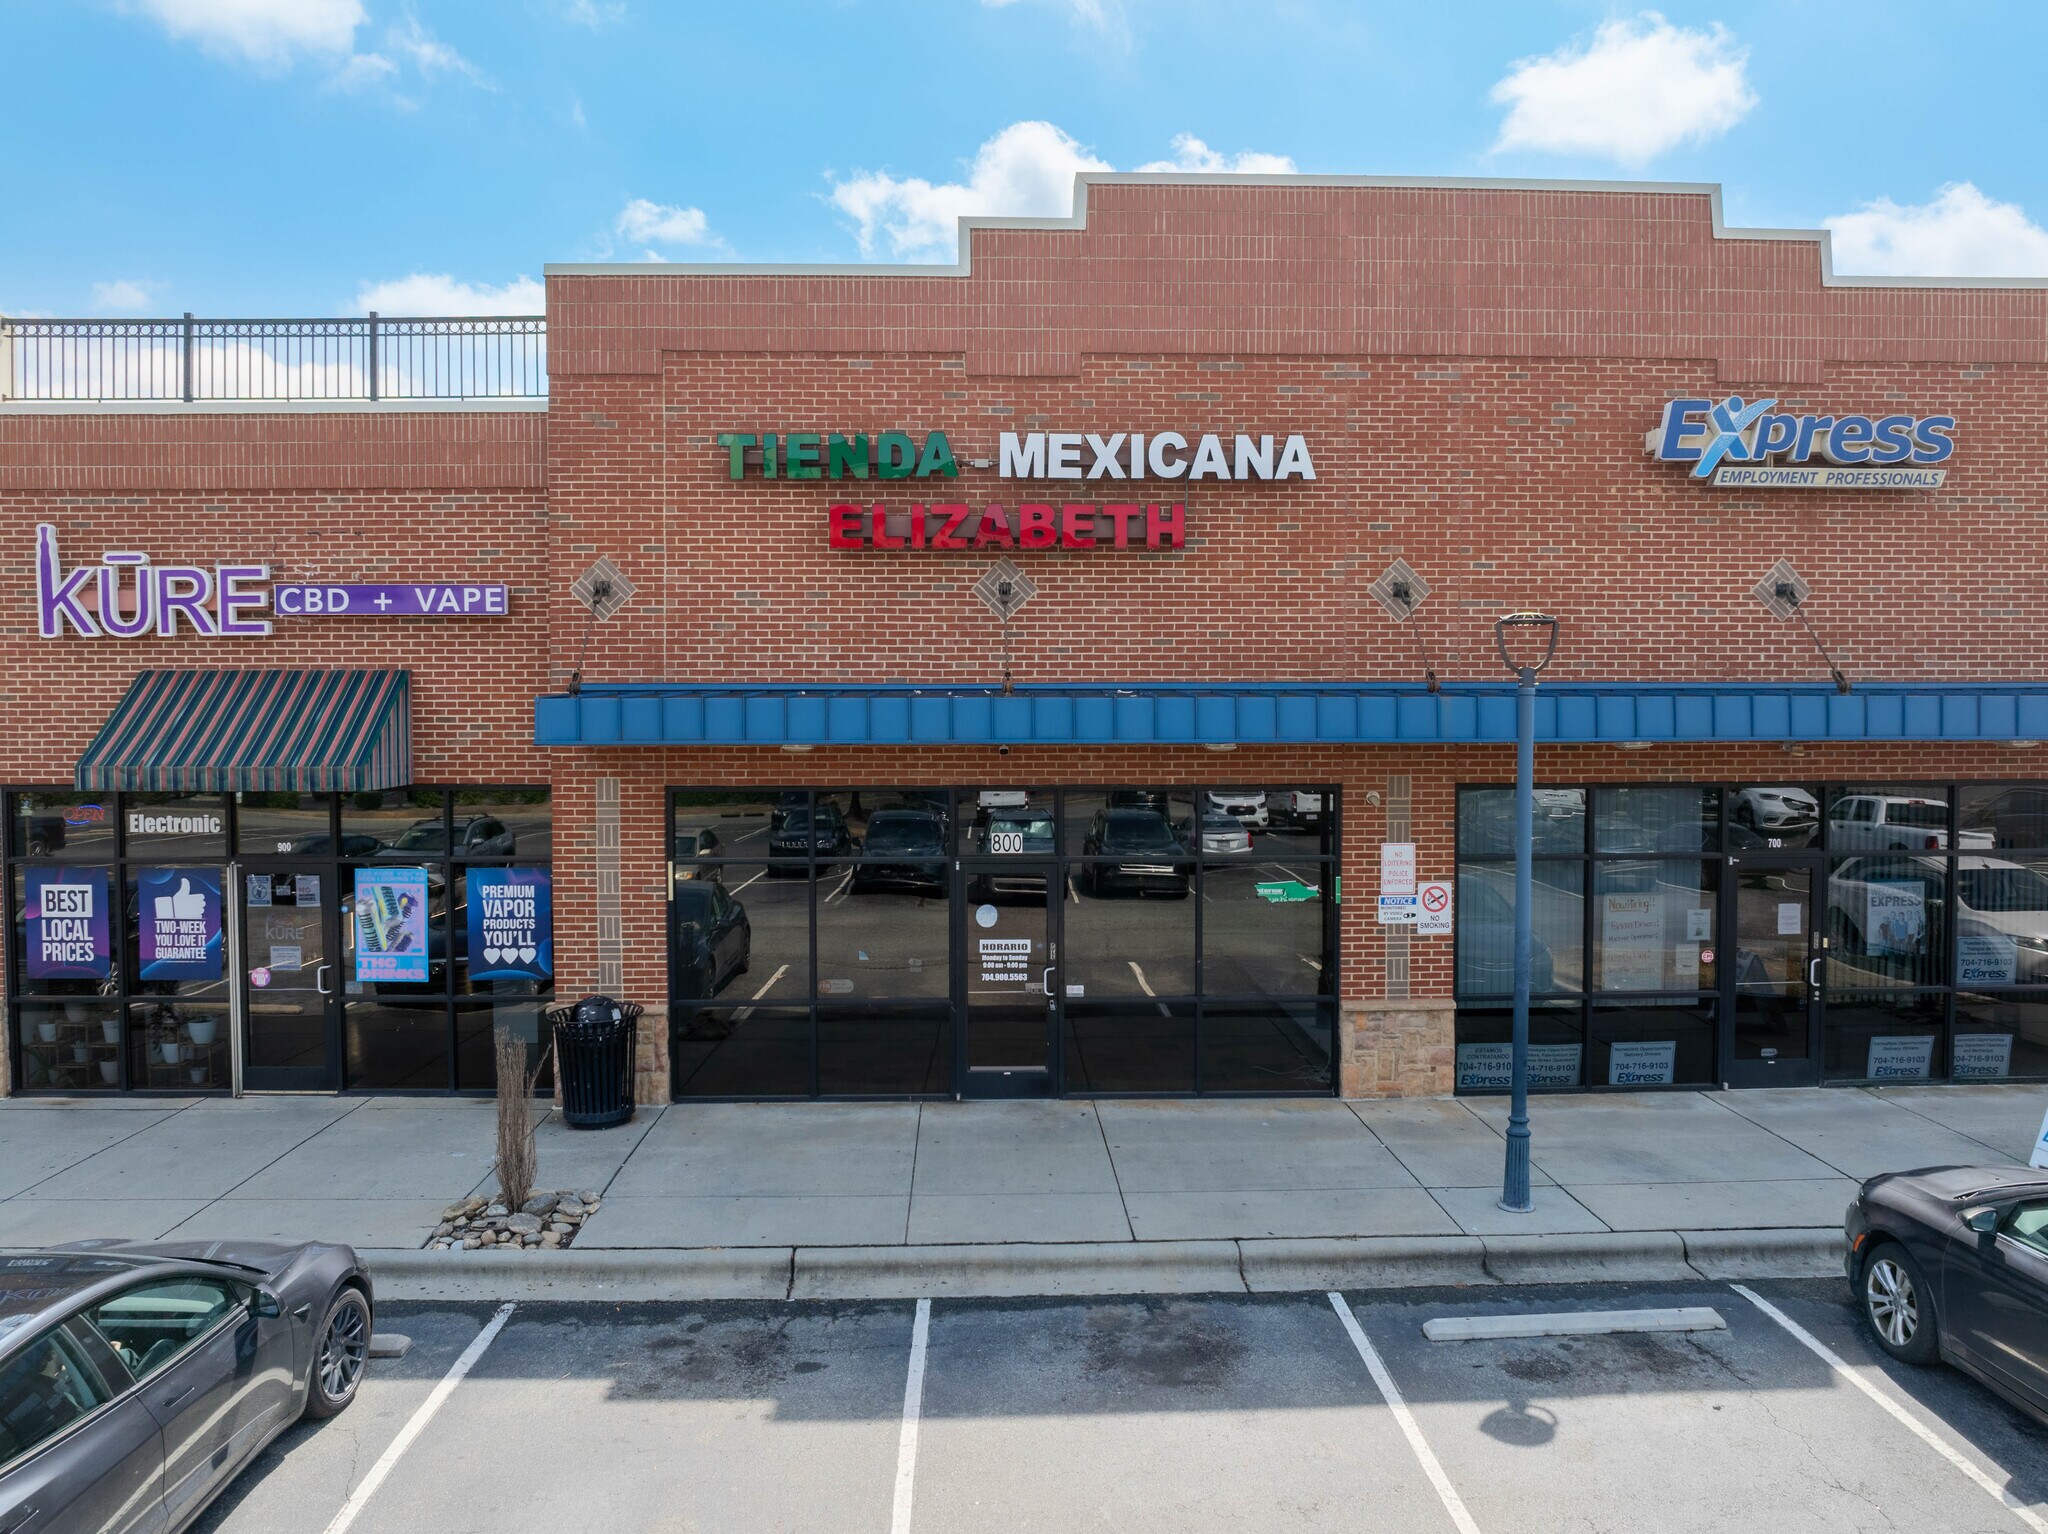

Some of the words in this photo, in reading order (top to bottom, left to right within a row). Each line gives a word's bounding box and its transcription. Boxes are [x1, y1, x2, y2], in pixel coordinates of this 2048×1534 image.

[716, 432, 959, 480] TIENDA
[999, 431, 1317, 480] MEXICANA
[1719, 470, 1819, 485] EMPLOYMENT
[1825, 471, 1941, 486] PROFESSIONALS
[829, 503, 1186, 549] ELIZABETH
[279, 587, 350, 613] CBD
[414, 587, 503, 613] VAPE
[63, 807, 104, 821] OPEN
[130, 814, 221, 833] Electronic
[277, 842, 292, 852] 900
[991, 833, 1022, 852] 800
[1768, 838, 1782, 848] 700
[482, 885, 535, 898] PREMIUM
[1870, 886, 1908, 896] WELCOME
[1912, 885, 1921, 894] TO
[45, 889, 89, 913] BEST
[1384, 897, 1413, 905] NOTICE
[1870, 895, 1921, 907] EXPRESS
[482, 899, 535, 918] VAPOR
[155, 921, 207, 934] TWO-WEEK
[360, 912, 375, 930] OUT
[483, 919, 536, 929] PRODUCTS
[41, 918, 94, 941] LOCAL
[155, 935, 173, 947] YOU
[174, 935, 197, 947] LOVE
[198, 935, 207, 947] IT
[363, 929, 382, 952] CHILL
[483, 931, 536, 946] YOU'LL
[42, 942, 95, 962] PRICES
[155, 947, 207, 960] GUARANTEE
[982, 943, 1028, 951] HORARIO
[358, 957, 398, 968] THC
[1961, 958, 2013, 967] 704-716-9103
[358, 968, 426, 980] DRINKS
[981, 973, 1028, 981] 704.900.5563
[1459, 1062, 1512, 1071] 704-716-910
[1614, 1061, 1669, 1070] 704-716-9103
[1873, 1056, 1926, 1065] 704-716-9103
